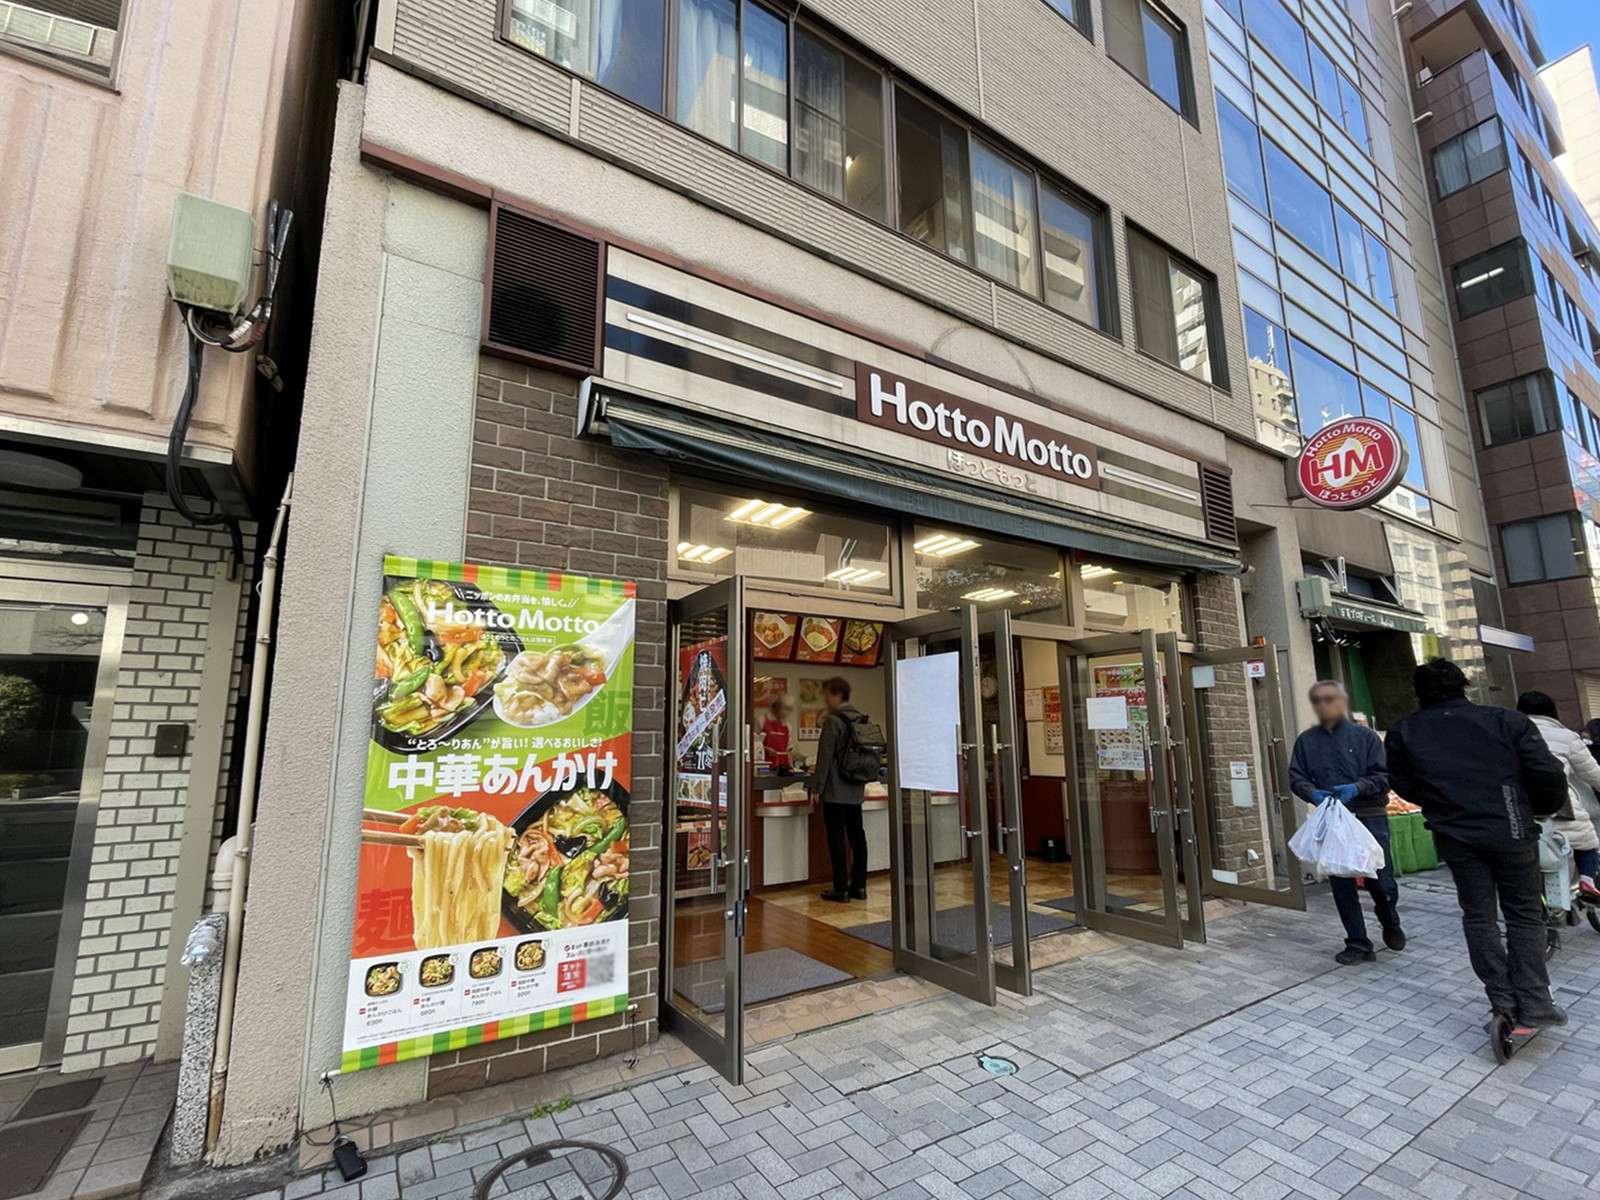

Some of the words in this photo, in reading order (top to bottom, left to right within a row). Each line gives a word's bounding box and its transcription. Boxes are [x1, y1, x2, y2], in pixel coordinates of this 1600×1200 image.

[948, 449, 1038, 493] ほっともっと
[1309, 442, 1385, 487] HM
[1319, 478, 1380, 501] ほっともっと
[583, 690, 630, 736] 飯
[387, 751, 618, 800] 中華あんかけ
[354, 889, 415, 953] 麺
